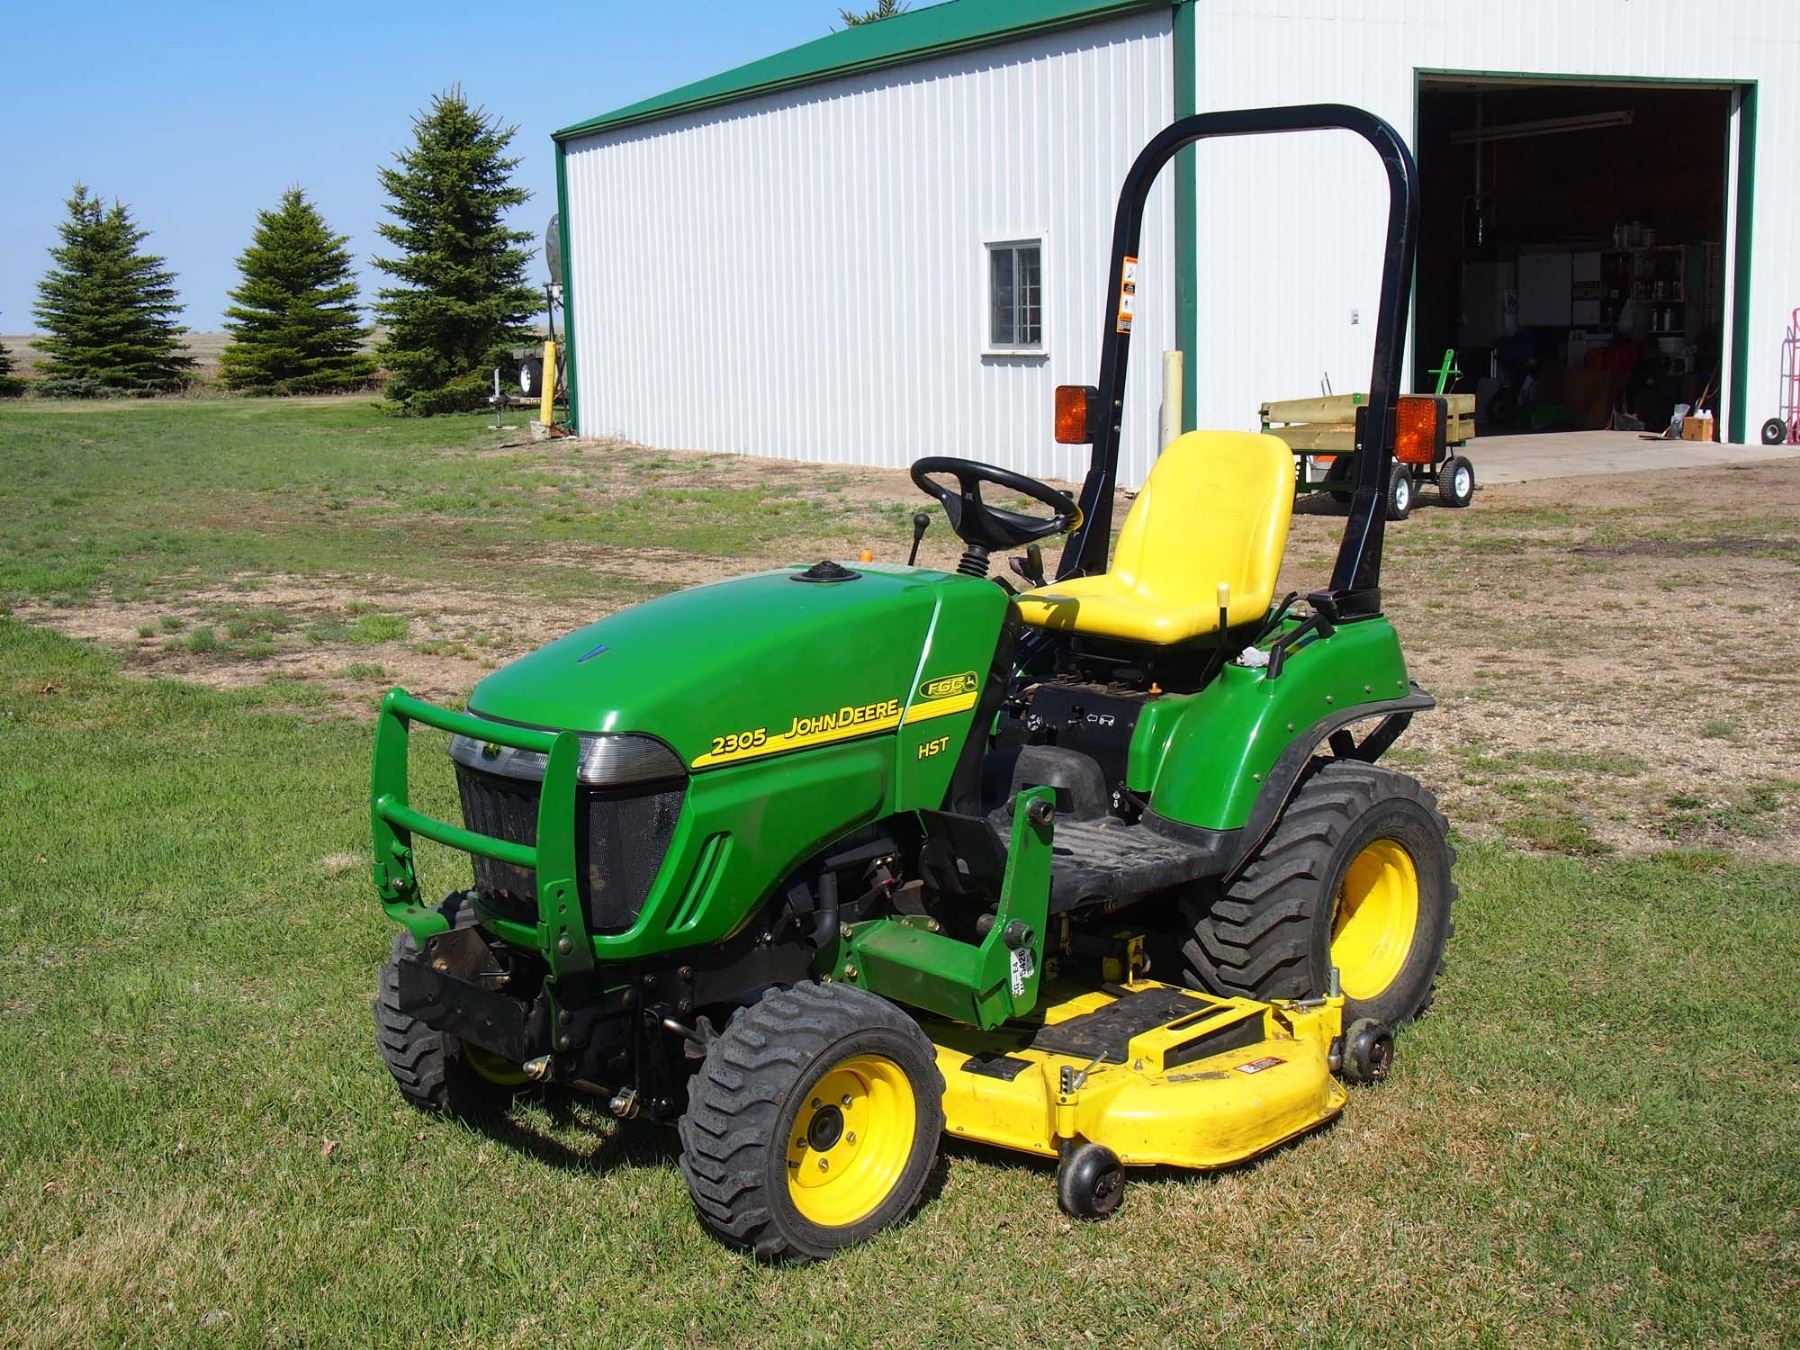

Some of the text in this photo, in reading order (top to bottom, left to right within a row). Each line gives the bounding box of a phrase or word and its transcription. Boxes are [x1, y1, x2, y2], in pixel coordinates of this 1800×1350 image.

[711, 698, 898, 756] 2305 JOHN DEERE
[918, 735, 950, 760] HST
